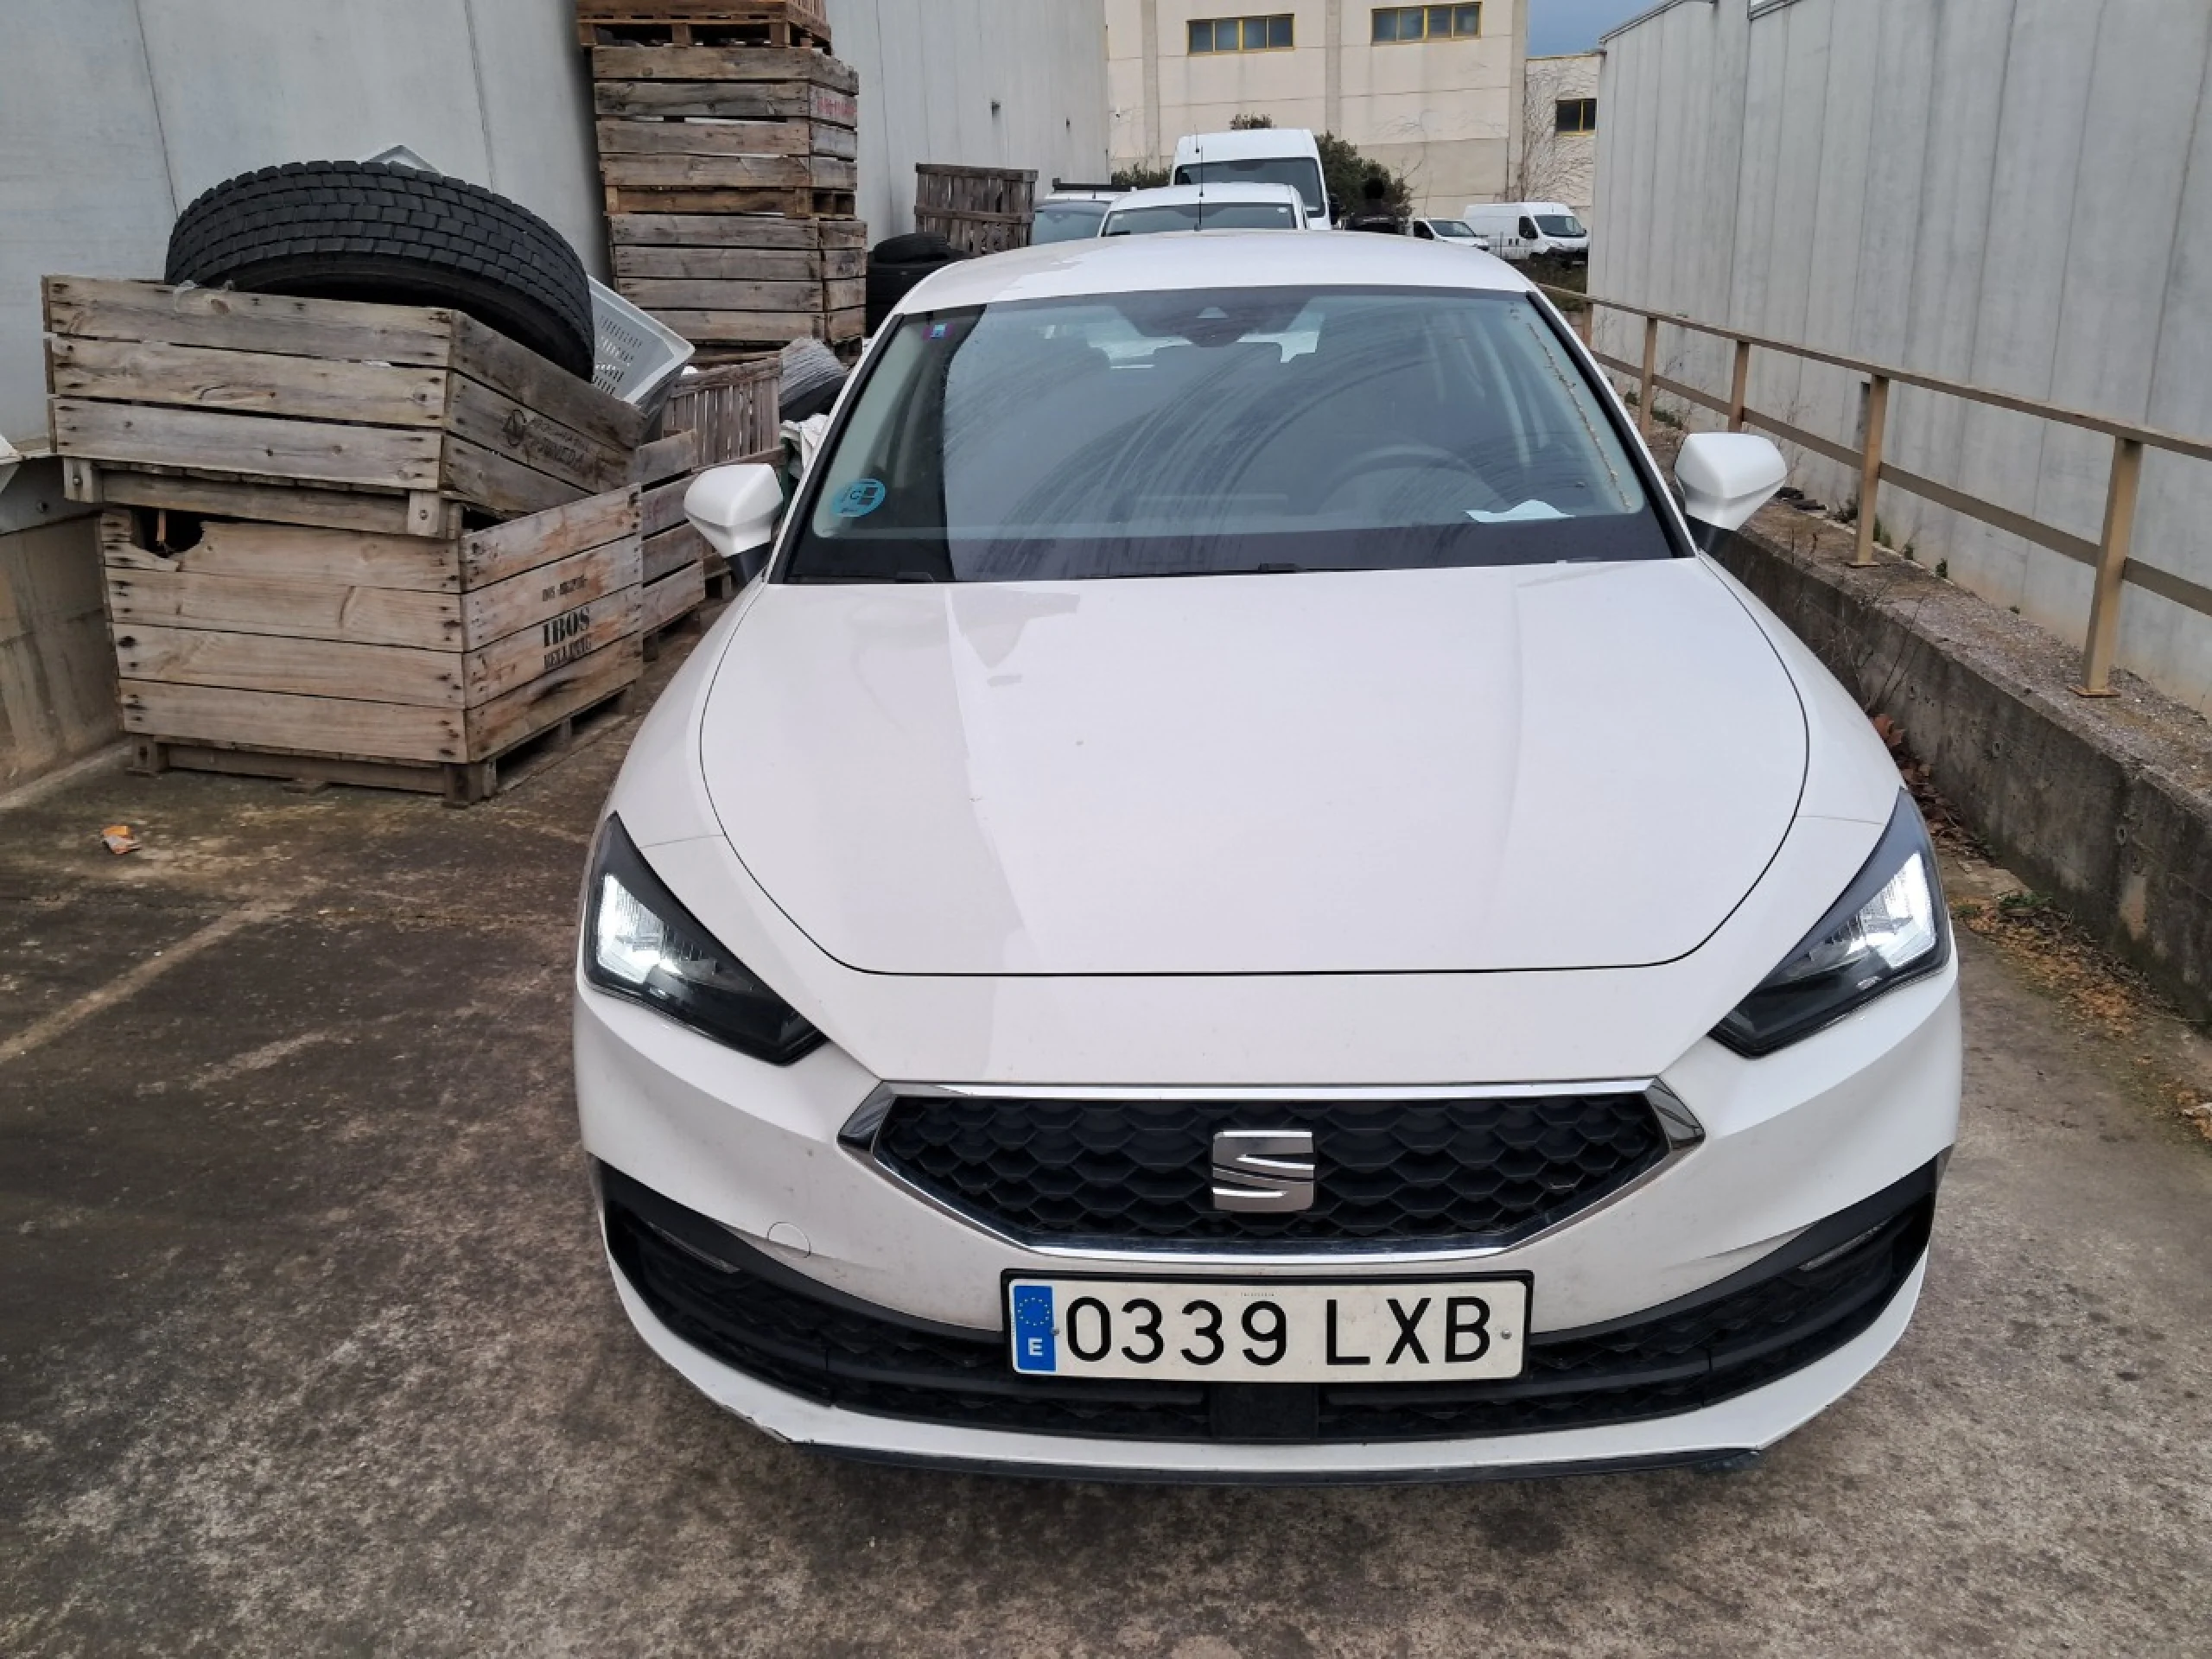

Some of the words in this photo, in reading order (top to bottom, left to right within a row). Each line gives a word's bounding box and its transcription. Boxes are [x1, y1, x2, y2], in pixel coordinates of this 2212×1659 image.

[1028, 1338, 1043, 1357] E
[1065, 1296, 1287, 1366] 0339
[1325, 1297, 1491, 1366] LXB
